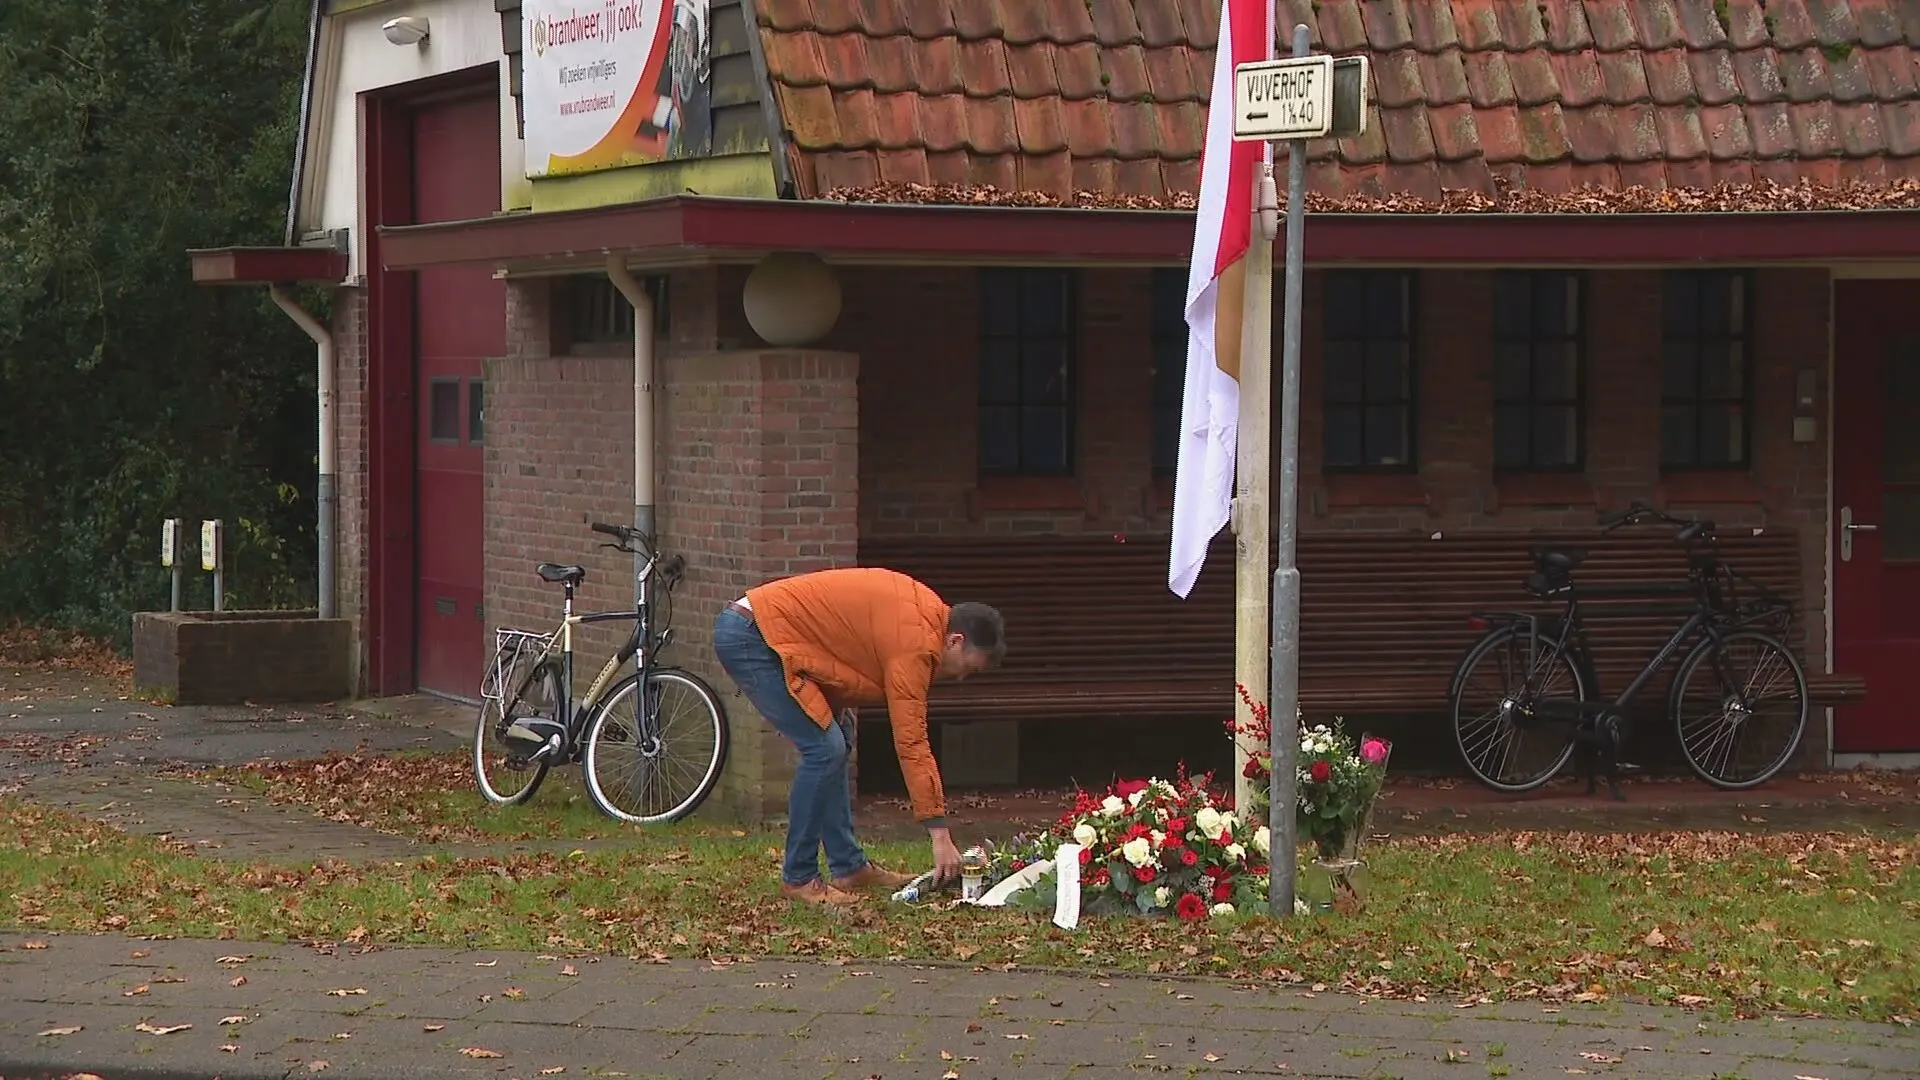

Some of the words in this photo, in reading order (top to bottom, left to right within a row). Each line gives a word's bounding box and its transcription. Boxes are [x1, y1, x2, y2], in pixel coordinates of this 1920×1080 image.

[548, 8, 604, 47] brandweer,
[605, 0, 616, 43] jij
[559, 66, 568, 88] Wij
[567, 64, 587, 83] zoeken
[587, 59, 617, 83] vrijwilligers
